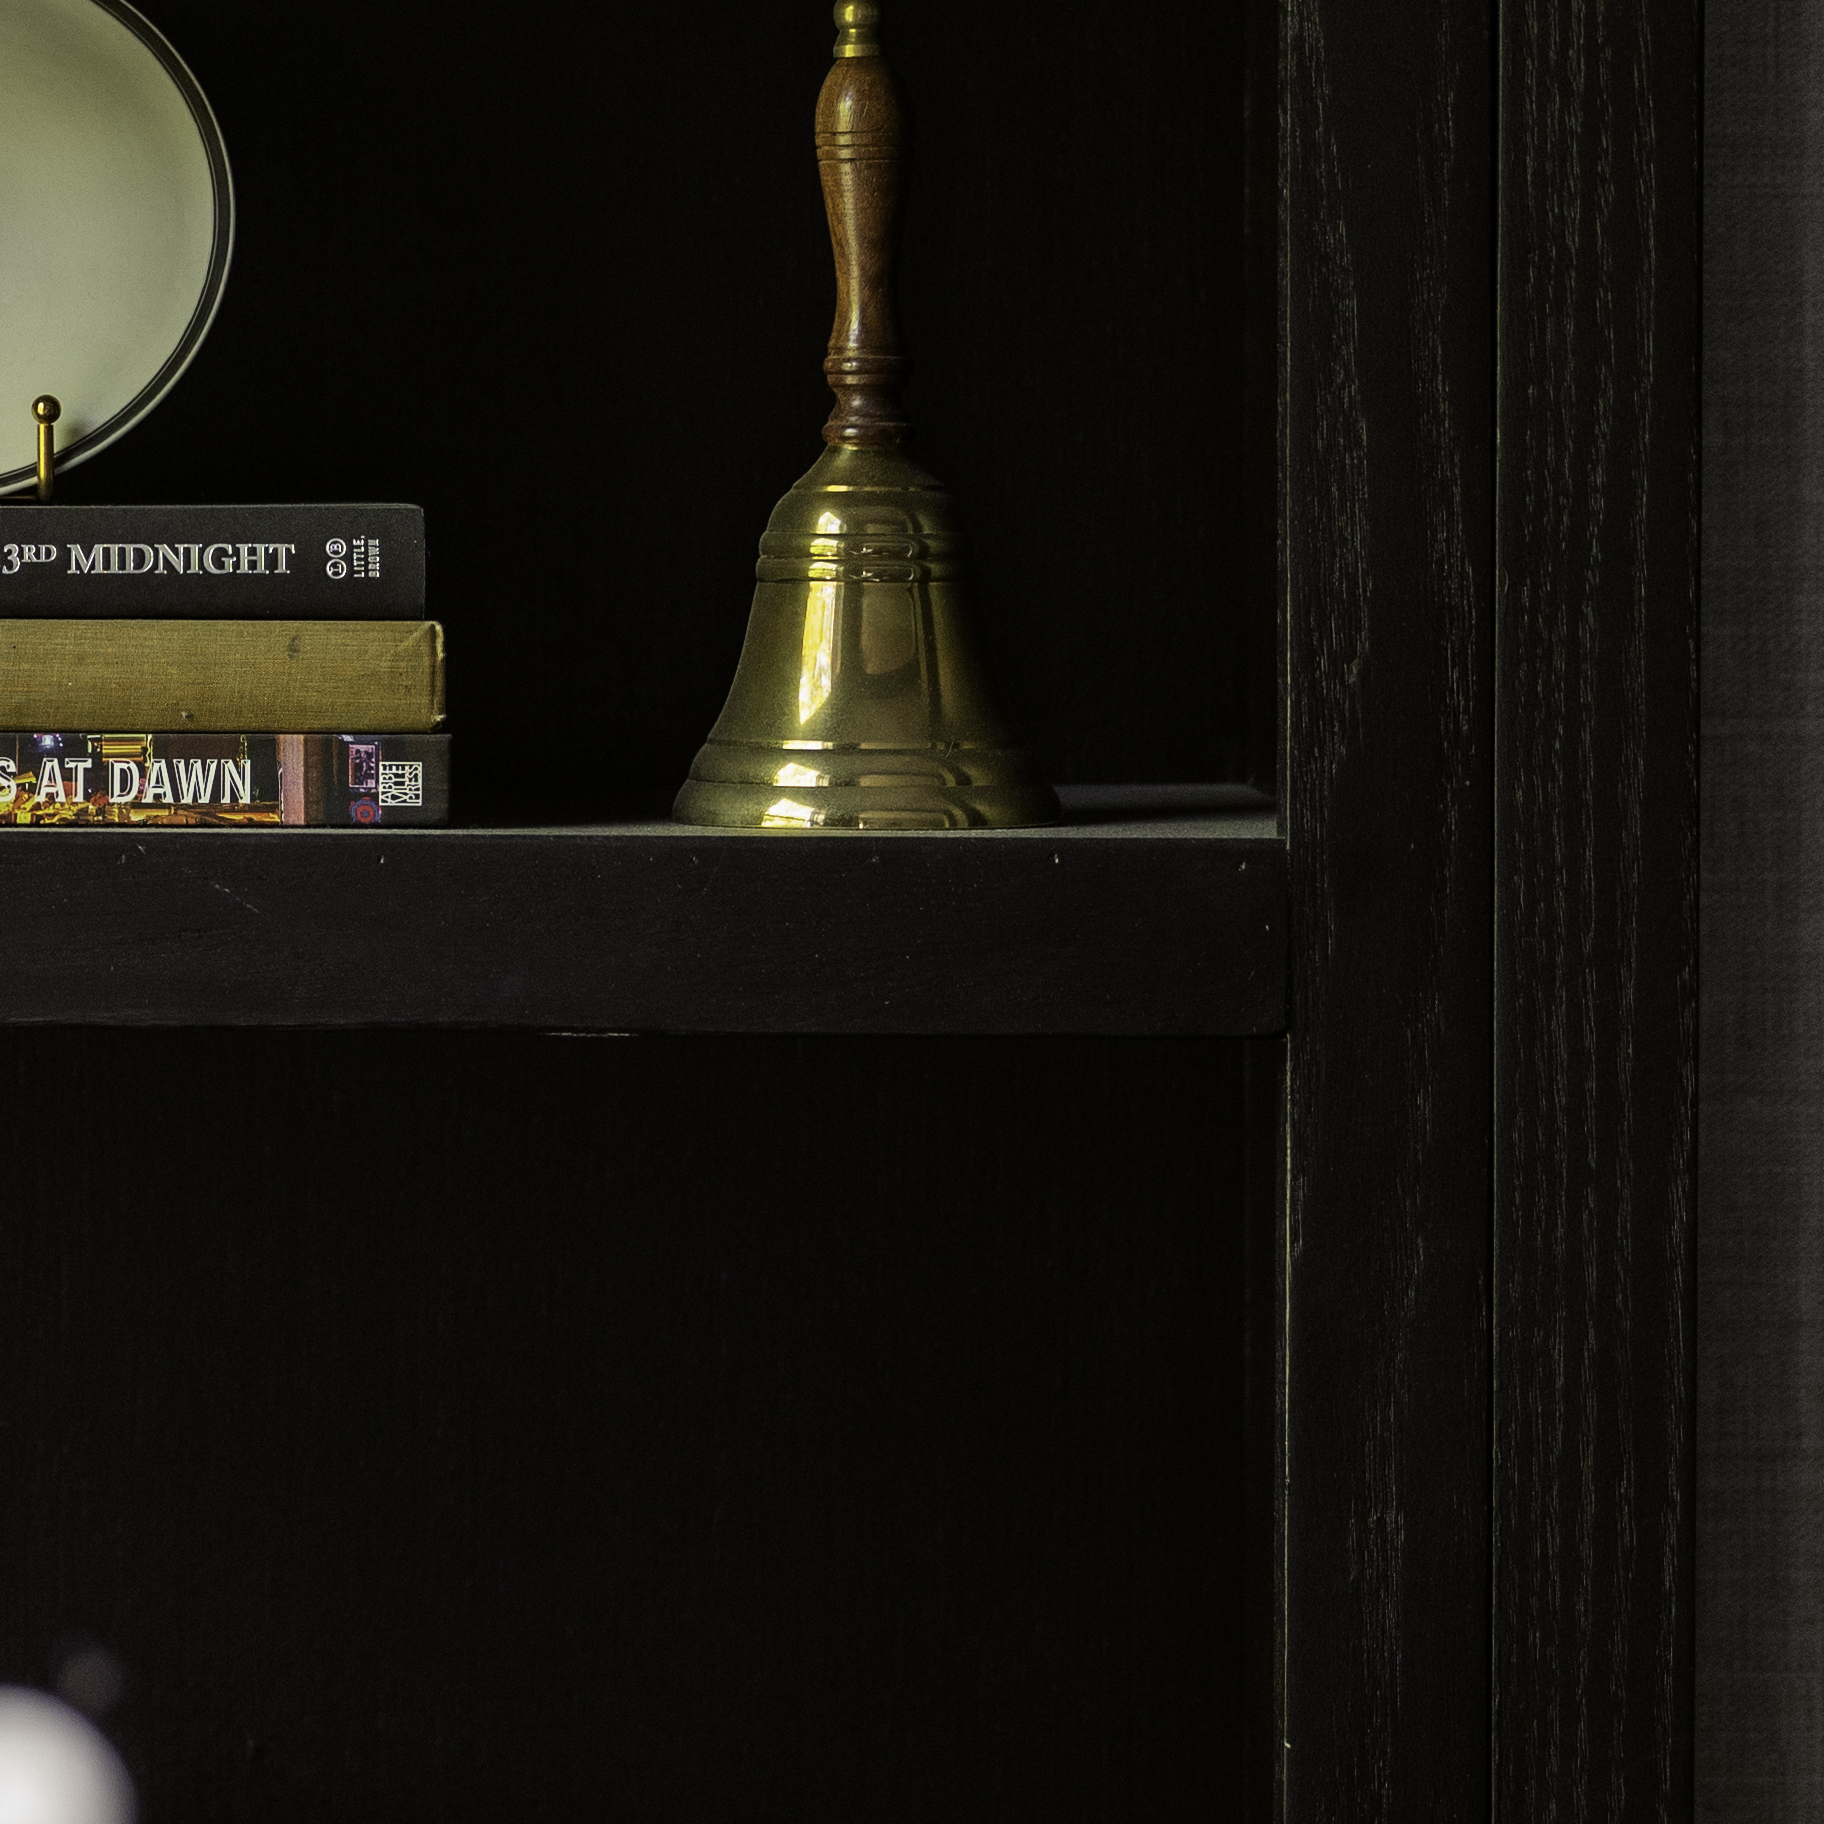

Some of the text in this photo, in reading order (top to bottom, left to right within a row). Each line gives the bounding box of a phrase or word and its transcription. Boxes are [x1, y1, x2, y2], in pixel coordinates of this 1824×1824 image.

[66, 542, 295, 575] MIDNIGHT
[353, 535, 365, 577] LITTLE,
[34, 758, 93, 803] AT
[108, 758, 251, 804] DAWN
[407, 764, 421, 803] PRESS
